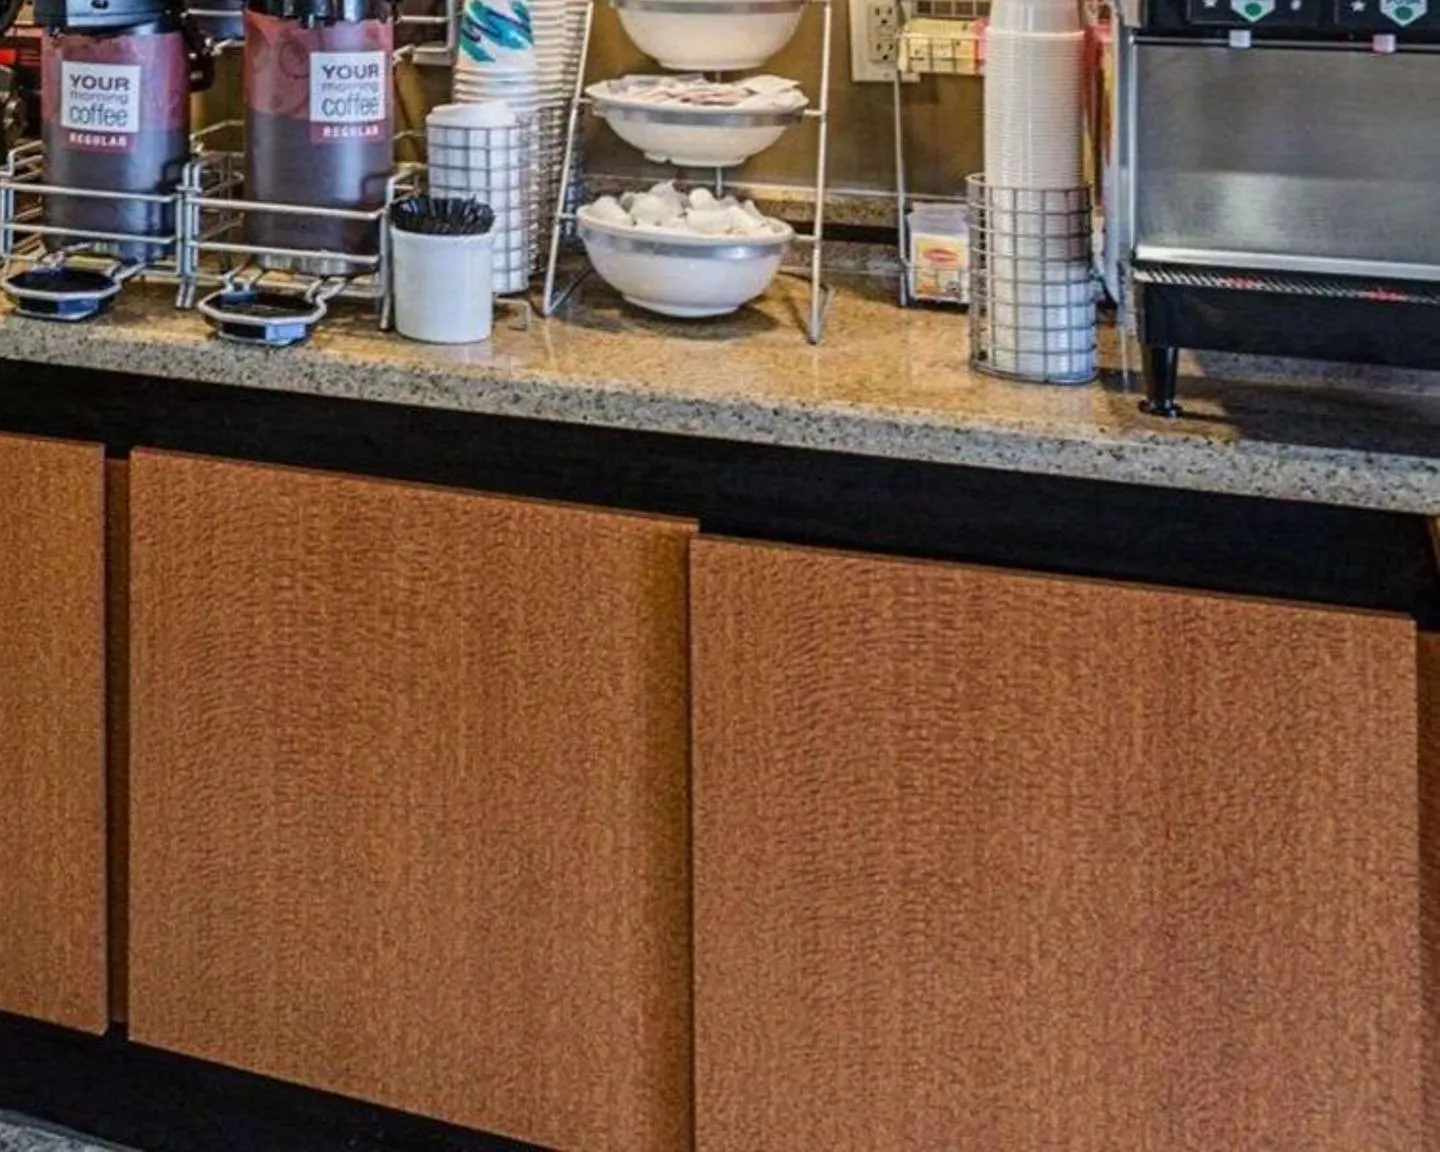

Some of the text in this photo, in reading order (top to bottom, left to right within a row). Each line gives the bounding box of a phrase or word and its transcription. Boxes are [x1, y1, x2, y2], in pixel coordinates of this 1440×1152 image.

[321, 62, 380, 80] YOUR
[70, 74, 130, 91] YOUR
[321, 92, 380, 117] coffee
[69, 102, 128, 126] coffee
[69, 132, 127, 147] REGULAR
[323, 125, 380, 138] REGULAR
